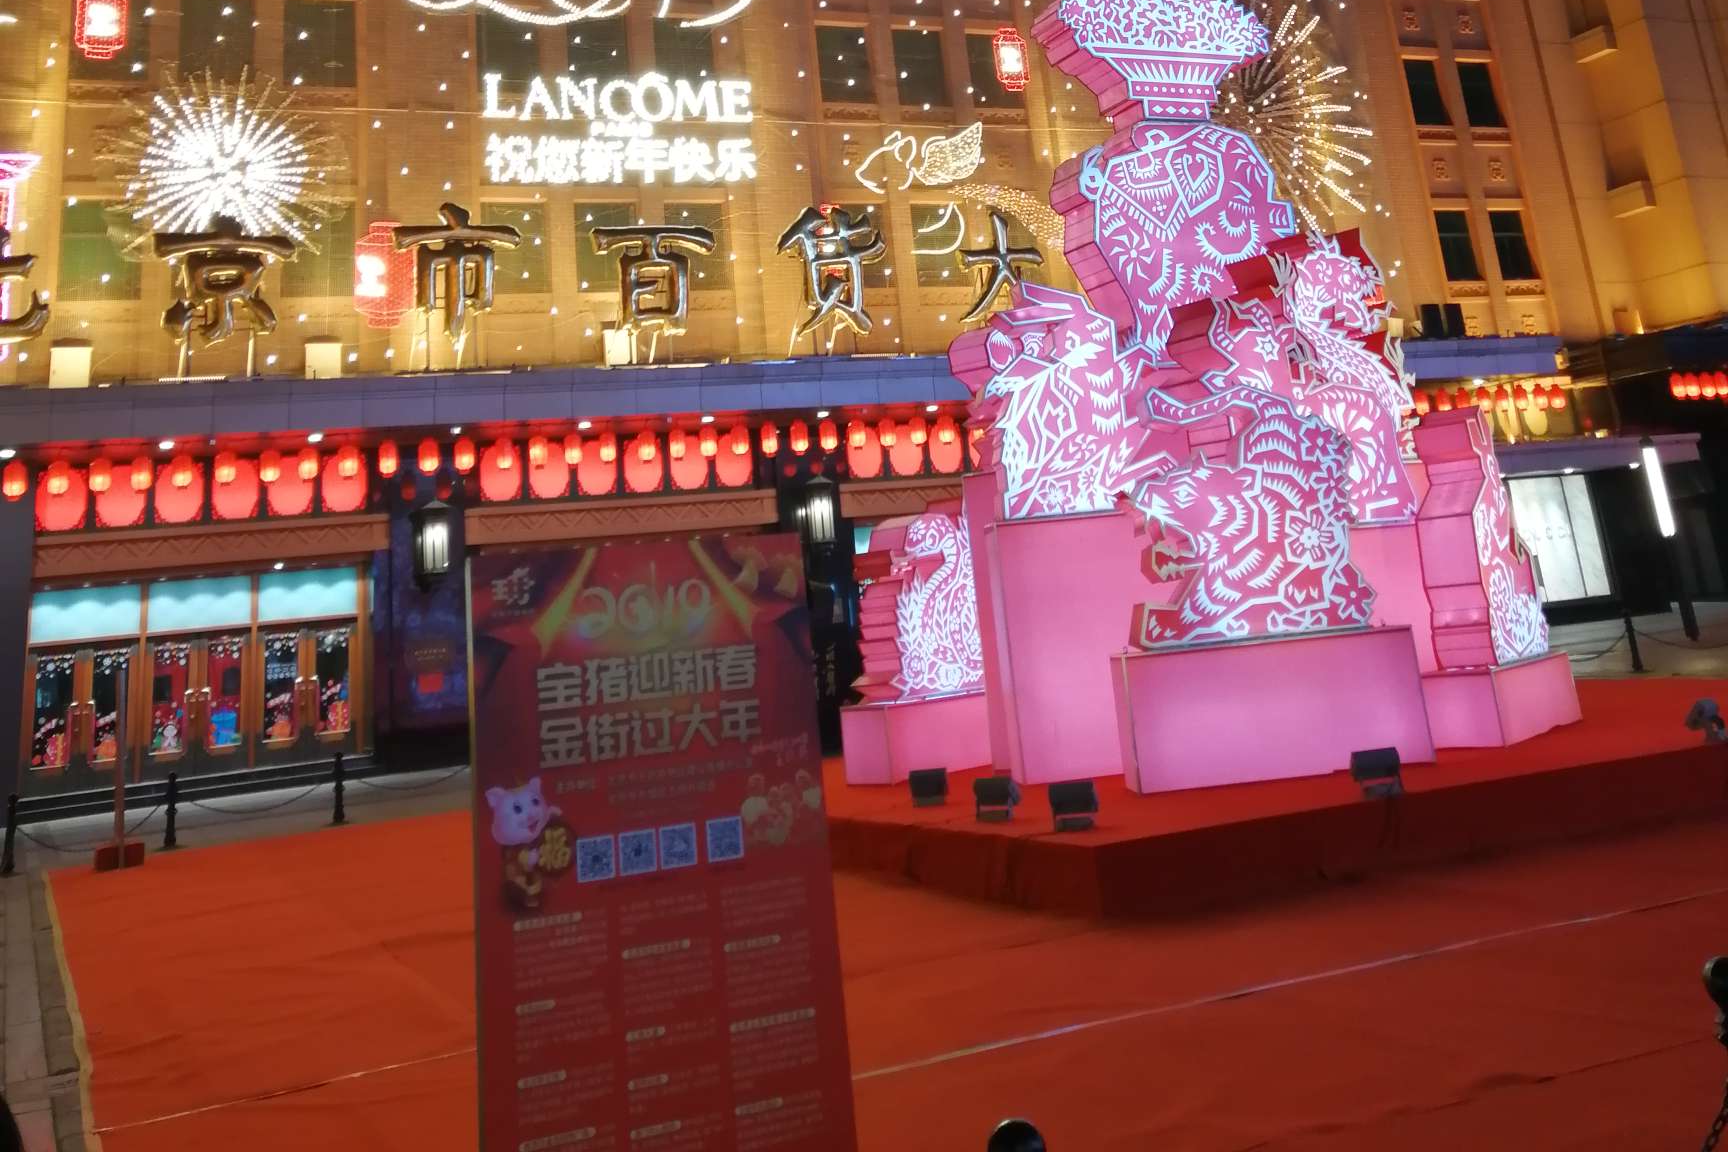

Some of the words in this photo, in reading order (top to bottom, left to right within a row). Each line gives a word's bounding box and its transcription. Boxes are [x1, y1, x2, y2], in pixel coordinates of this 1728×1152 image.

[482, 72, 754, 123] LANCÔME
[536, 644, 758, 712] 宝猪迎新春
[538, 698, 762, 769] 金街过大年
